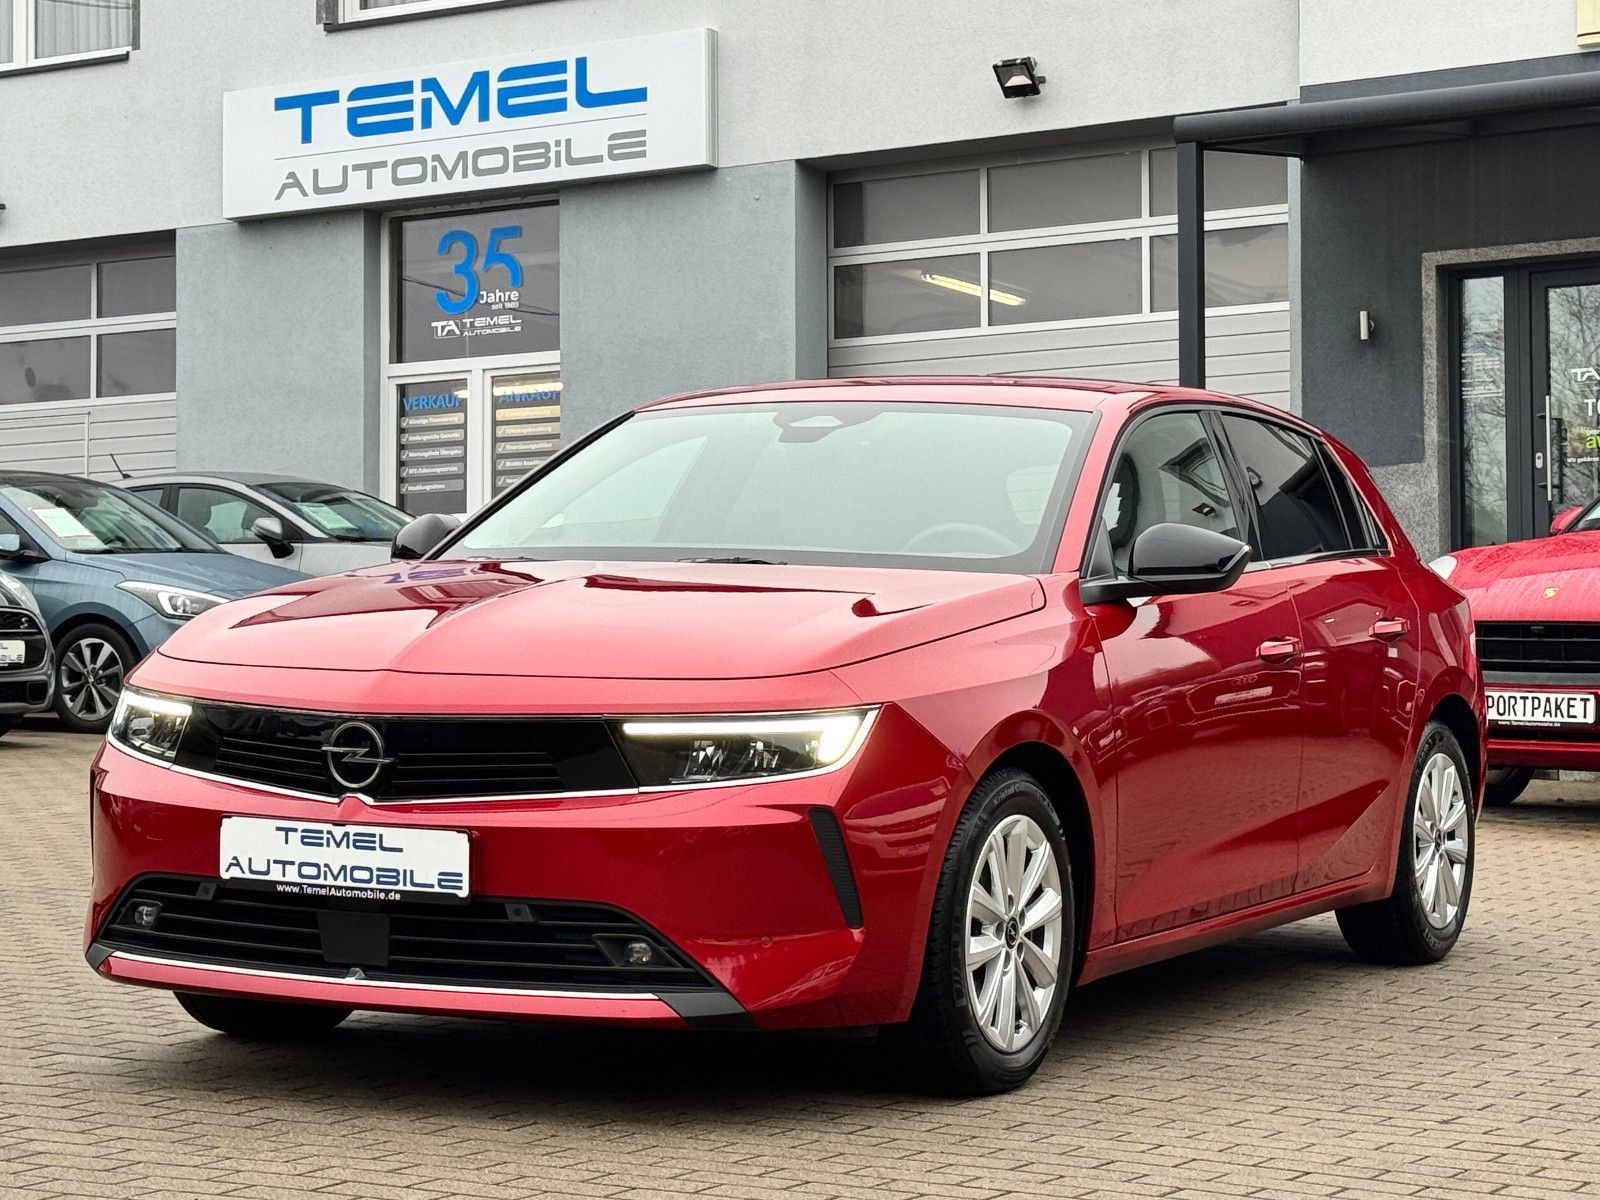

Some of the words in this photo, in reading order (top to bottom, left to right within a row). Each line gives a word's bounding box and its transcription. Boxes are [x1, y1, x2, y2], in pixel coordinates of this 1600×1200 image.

[275, 56, 648, 144] TEMEL
[275, 129, 648, 200] AUTOMOBILE
[435, 225, 523, 314] 35
[479, 288, 519, 304] Jahre
[462, 314, 522, 328] TEMEL
[403, 394, 462, 411] VERKAUF
[1584, 398, 1600, 417] T
[1585, 435, 1600, 449] a
[275, 826, 404, 853] TEMEL
[225, 856, 464, 891] AUTOMOBILE
[276, 883, 402, 902] www.TemelAutomobile.de
